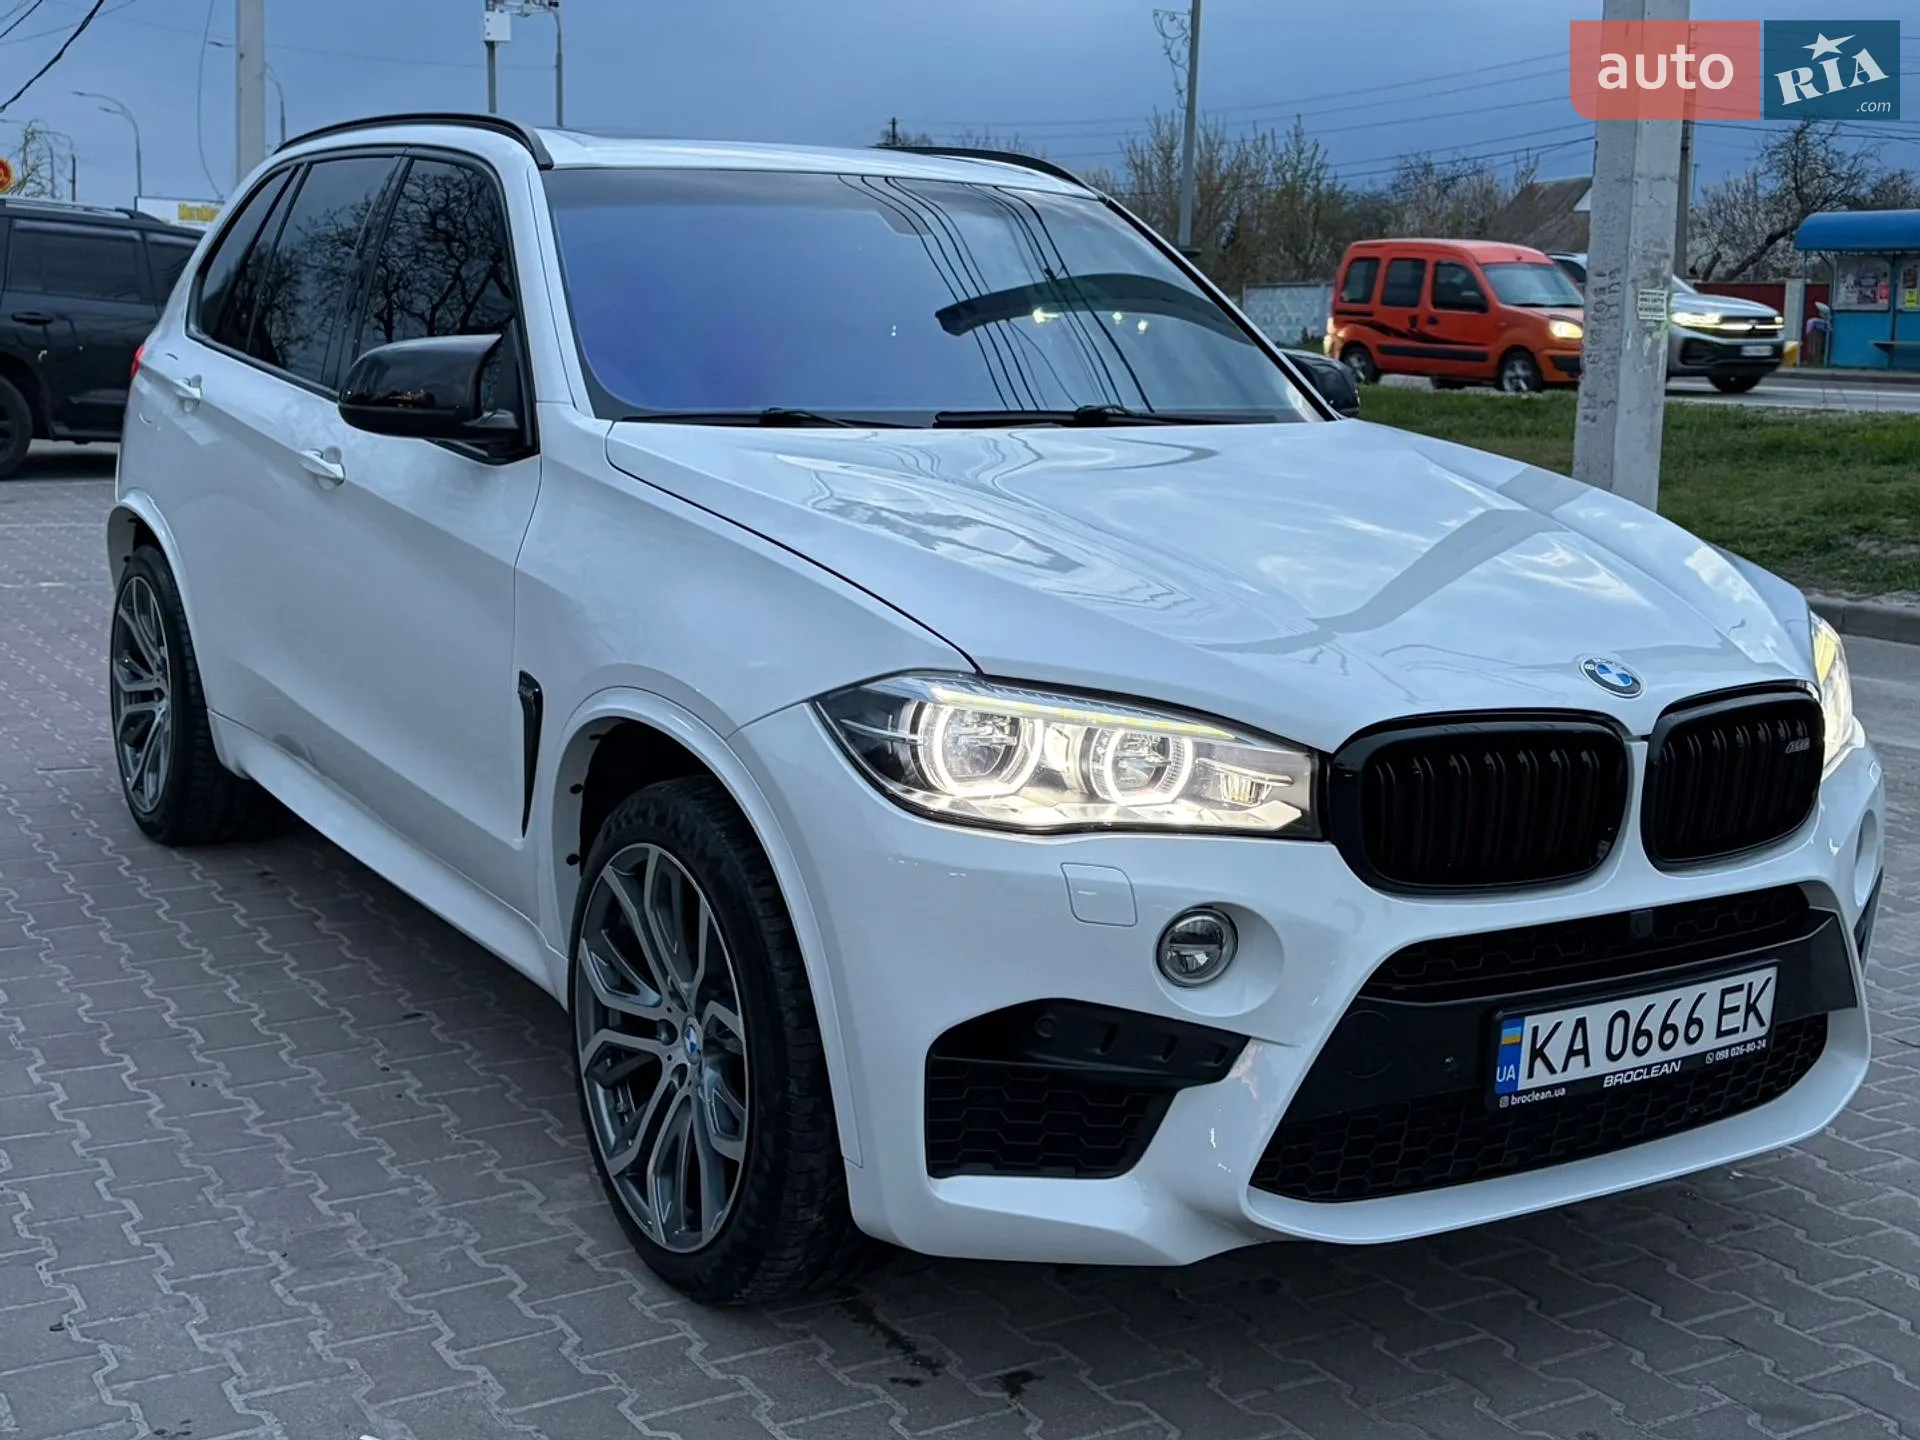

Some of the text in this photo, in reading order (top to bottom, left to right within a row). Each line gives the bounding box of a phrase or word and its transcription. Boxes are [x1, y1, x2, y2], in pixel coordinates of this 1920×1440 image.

[1526, 977, 1773, 1081] KA 0666 EK
[1495, 1063, 1516, 1083] UA
[1603, 1060, 1682, 1089] BROCLEAN
[1510, 1086, 1567, 1106] broclean.ua
